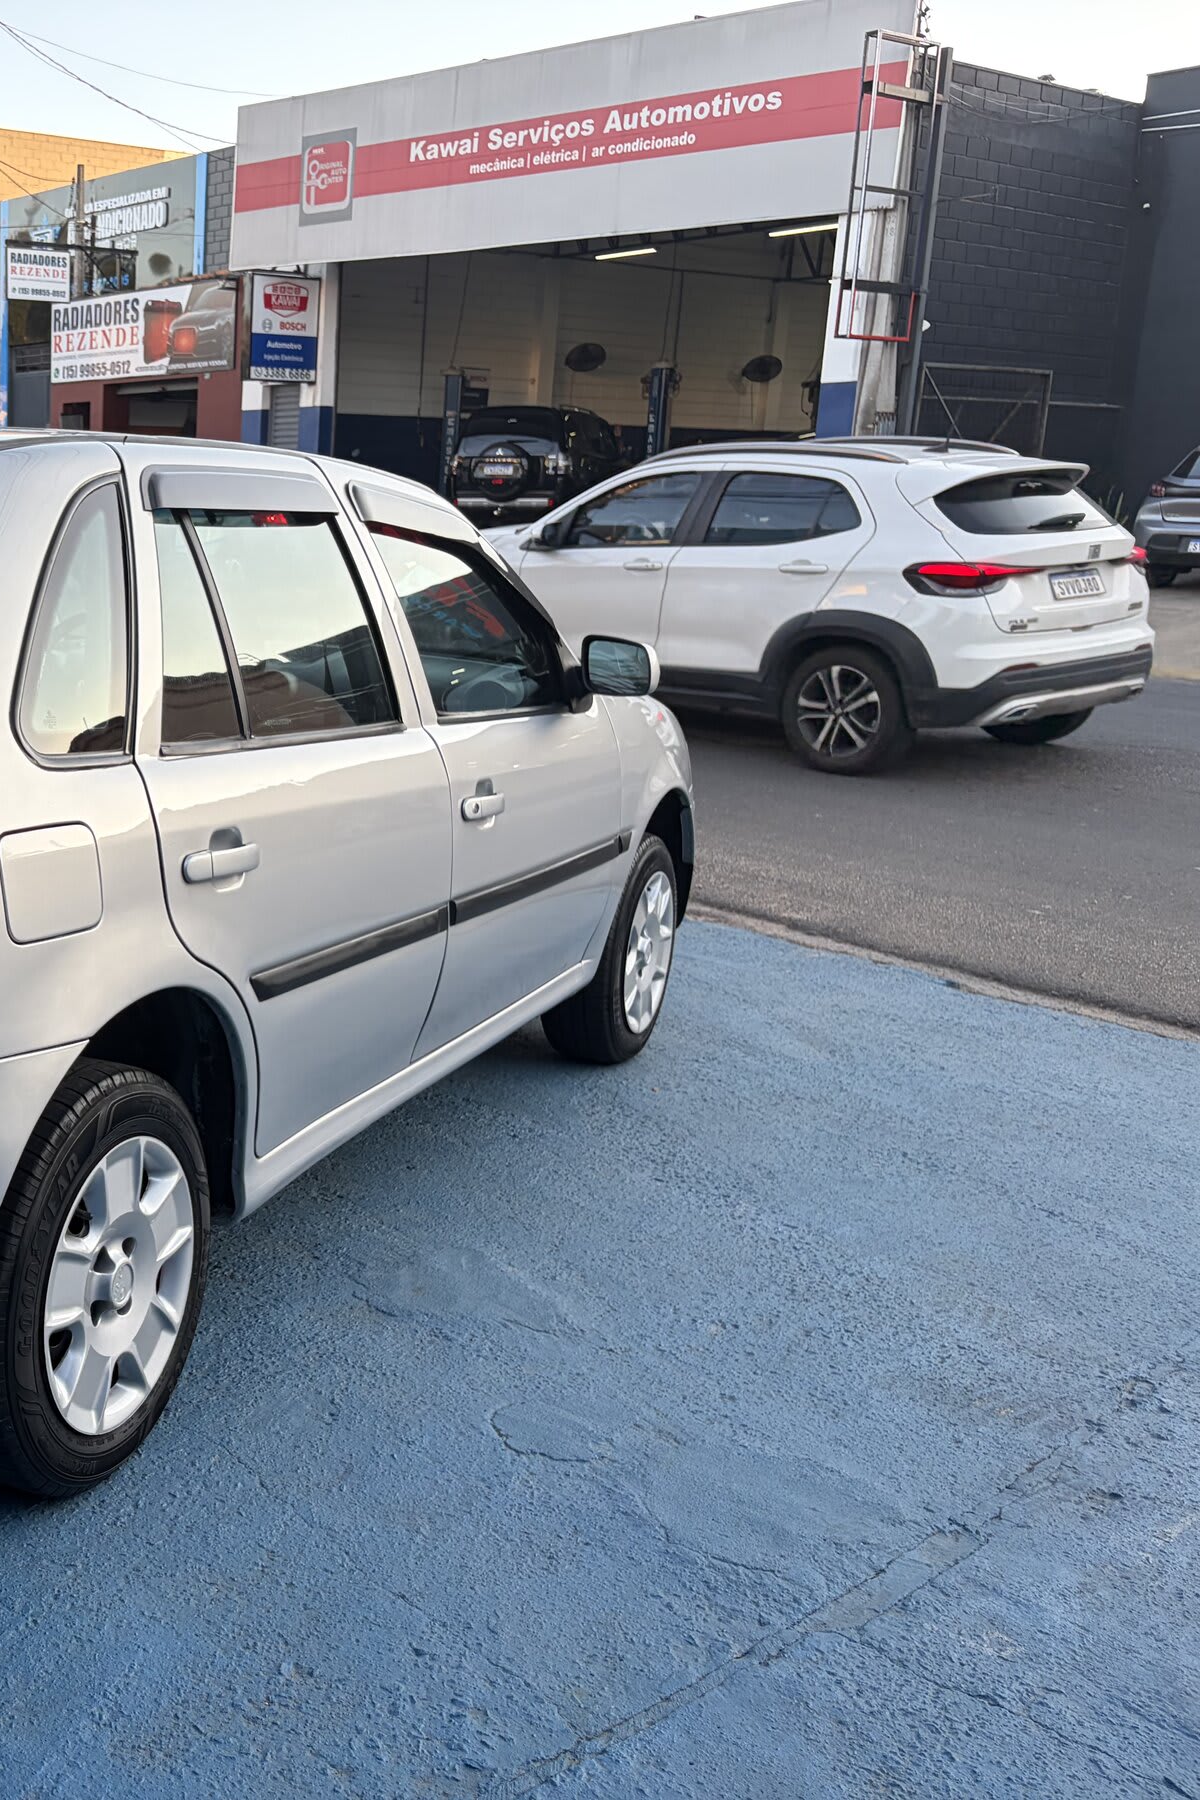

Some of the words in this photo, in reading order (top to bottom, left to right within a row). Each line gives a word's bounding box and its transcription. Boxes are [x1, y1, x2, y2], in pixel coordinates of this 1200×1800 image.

[410, 138, 479, 163] Kawai
[487, 117, 594, 151] Serviços
[603, 90, 782, 133] Automotivos
[469, 155, 525, 175] mecânica
[532, 147, 579, 166] elétrica
[591, 145, 606, 159] ar
[607, 130, 696, 156] condicionado
[10, 252, 68, 268] RADIADORES
[10, 266, 67, 280] REZENDE
[271, 294, 300, 307] KAWAI
[53, 298, 140, 333] RADIADORES
[279, 321, 307, 332] BOSCH
[53, 325, 140, 354] REZENDE
[79, 360, 132, 378] 99855-0512
